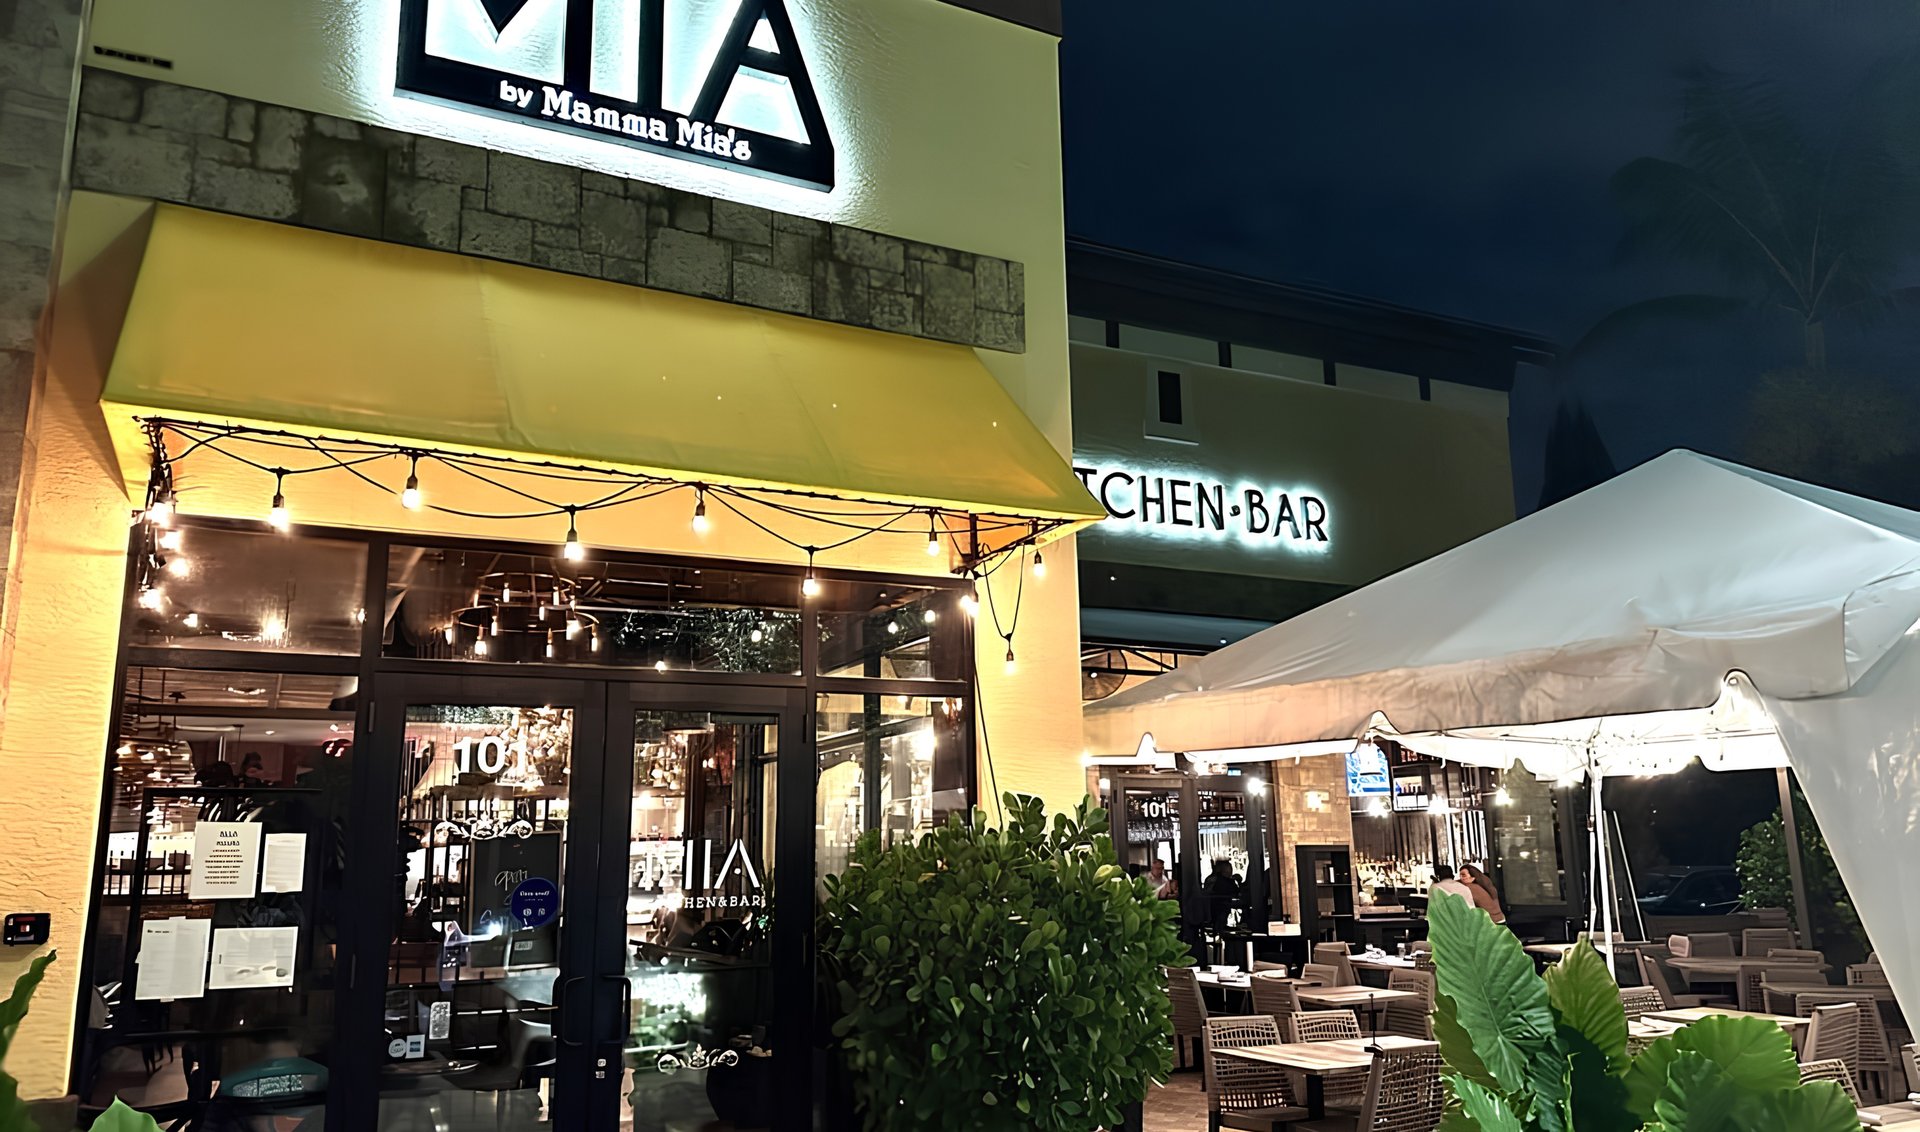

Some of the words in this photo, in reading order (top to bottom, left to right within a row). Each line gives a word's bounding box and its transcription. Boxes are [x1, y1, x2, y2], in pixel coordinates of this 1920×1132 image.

[500, 80, 533, 109] by
[542, 86, 668, 144] Mamma
[676, 117, 752, 161] Mia's
[1245, 489, 1328, 541] BAR
[453, 736, 528, 774] 101
[1141, 802, 1166, 817] 101
